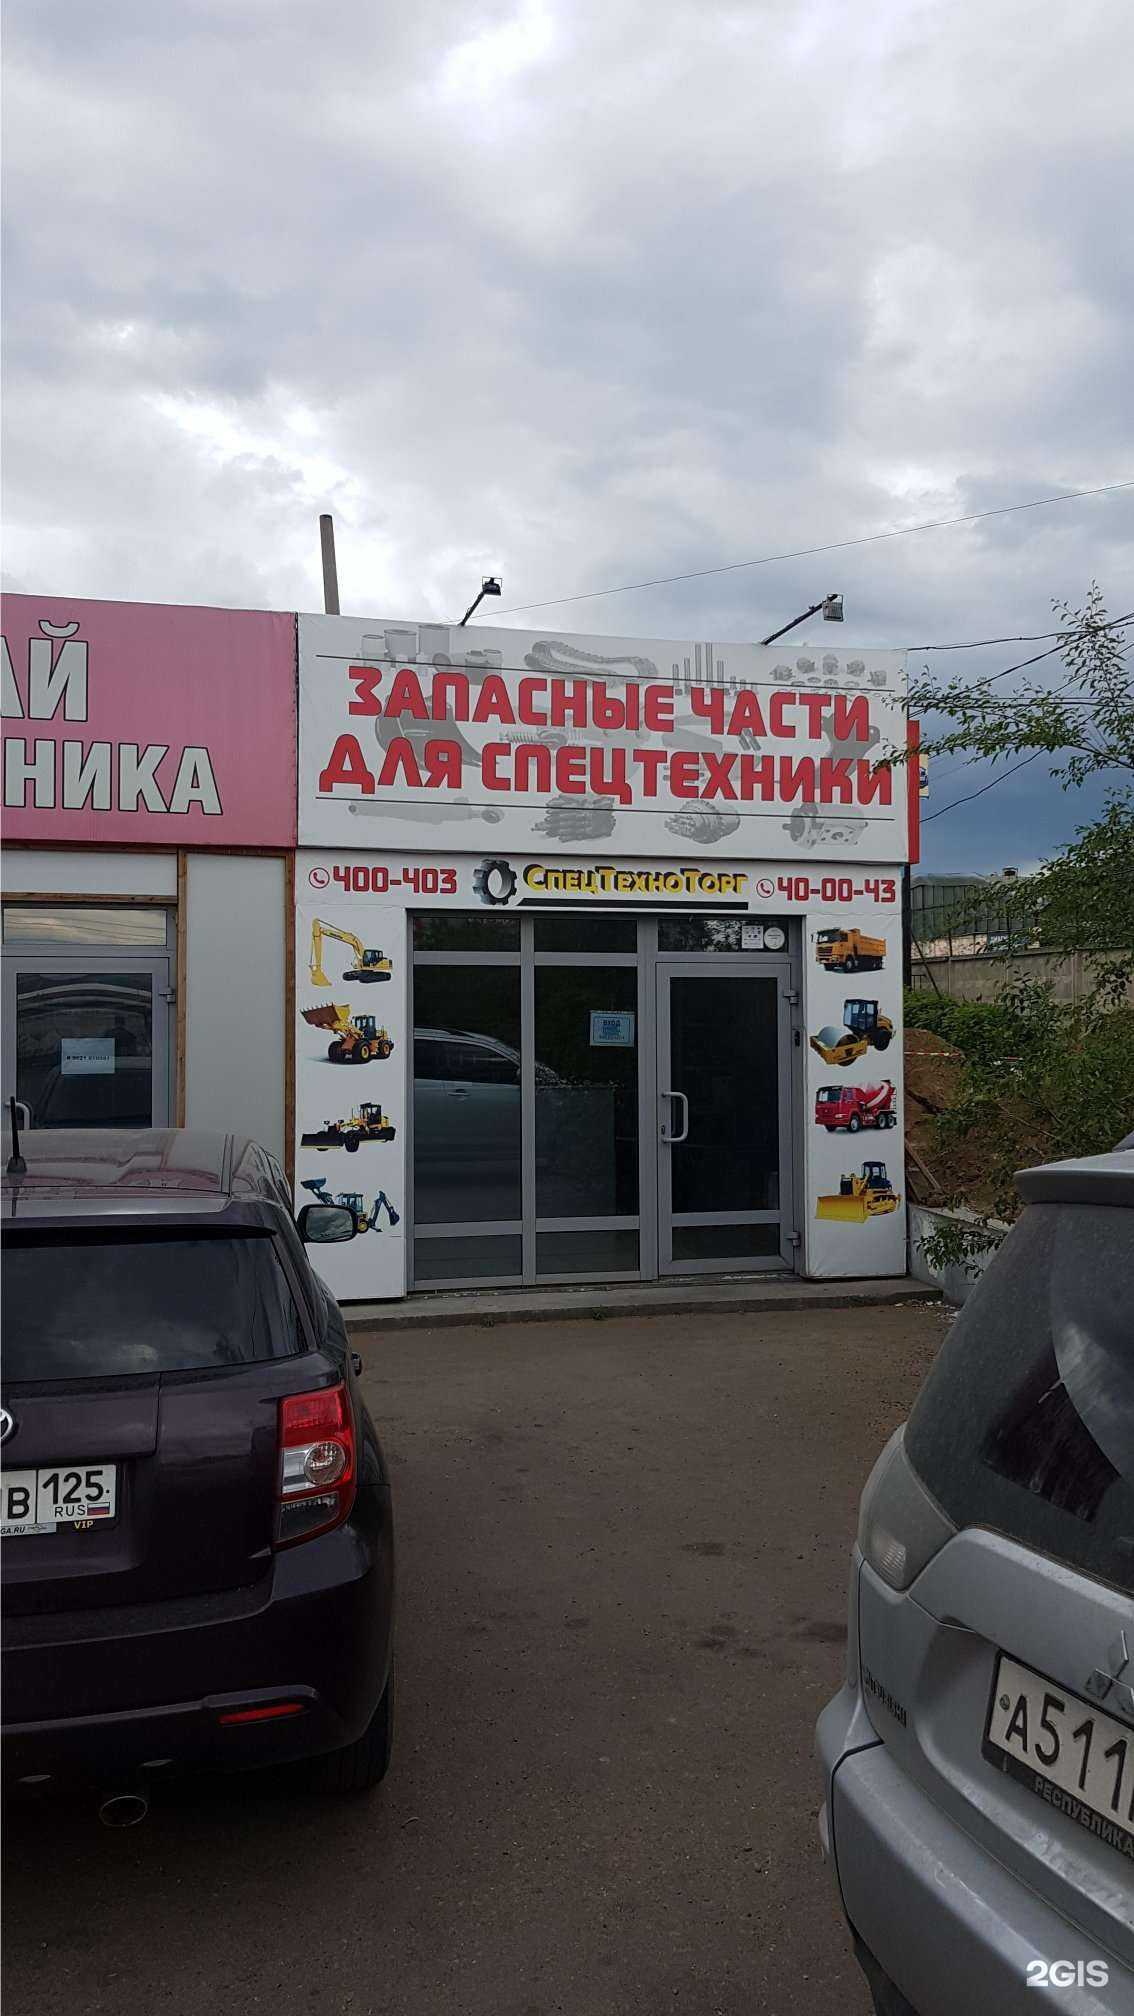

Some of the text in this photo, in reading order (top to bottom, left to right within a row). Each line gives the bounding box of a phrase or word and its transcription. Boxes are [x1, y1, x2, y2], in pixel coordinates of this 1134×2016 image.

[348, 665, 870, 741] ЗАПАСНЫЕ ЧАСТИ
[319, 733, 893, 805] ДЛЯ СПЕЦТЕХНИКИ
[333, 866, 458, 893] 400-403
[778, 876, 896, 902] 40-00-43
[42, 1470, 104, 1505] 125
[54, 1504, 86, 1518] RUS
[74, 1520, 94, 1529] VIP
[1004, 1694, 1134, 1822] А511
